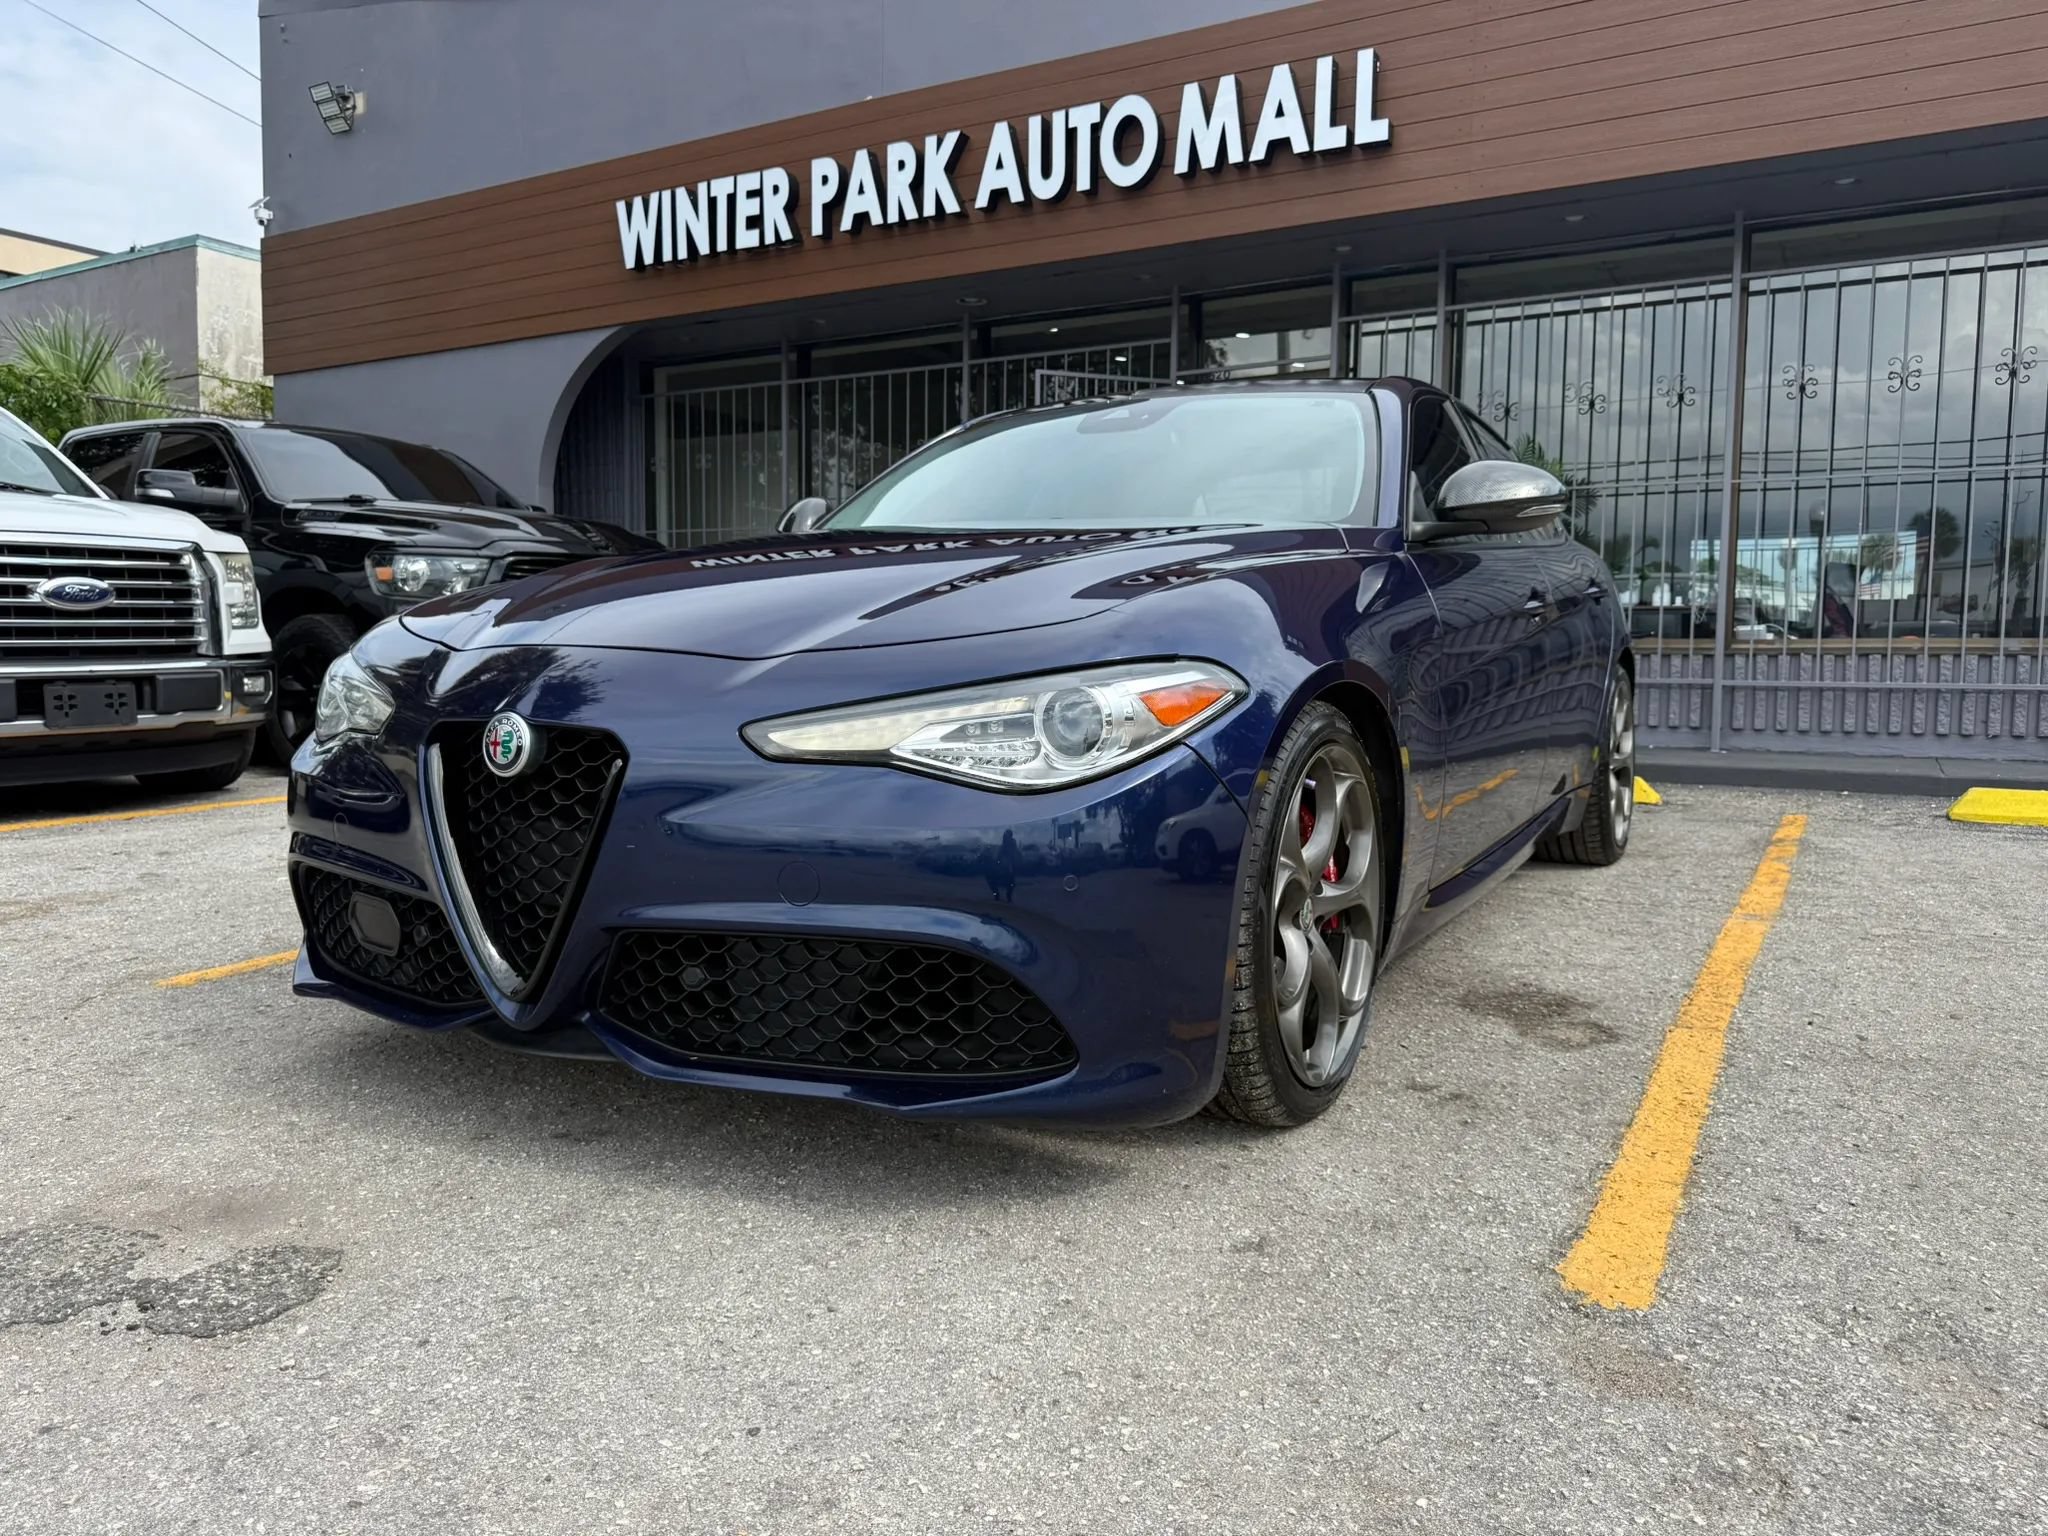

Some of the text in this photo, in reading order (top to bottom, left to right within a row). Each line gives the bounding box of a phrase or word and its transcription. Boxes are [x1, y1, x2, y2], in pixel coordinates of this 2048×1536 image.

[616, 47, 1390, 270] WINTER PARK AUTO MALL
[62, 584, 100, 600] Ford
[502, 718, 523, 746] ROMEO
